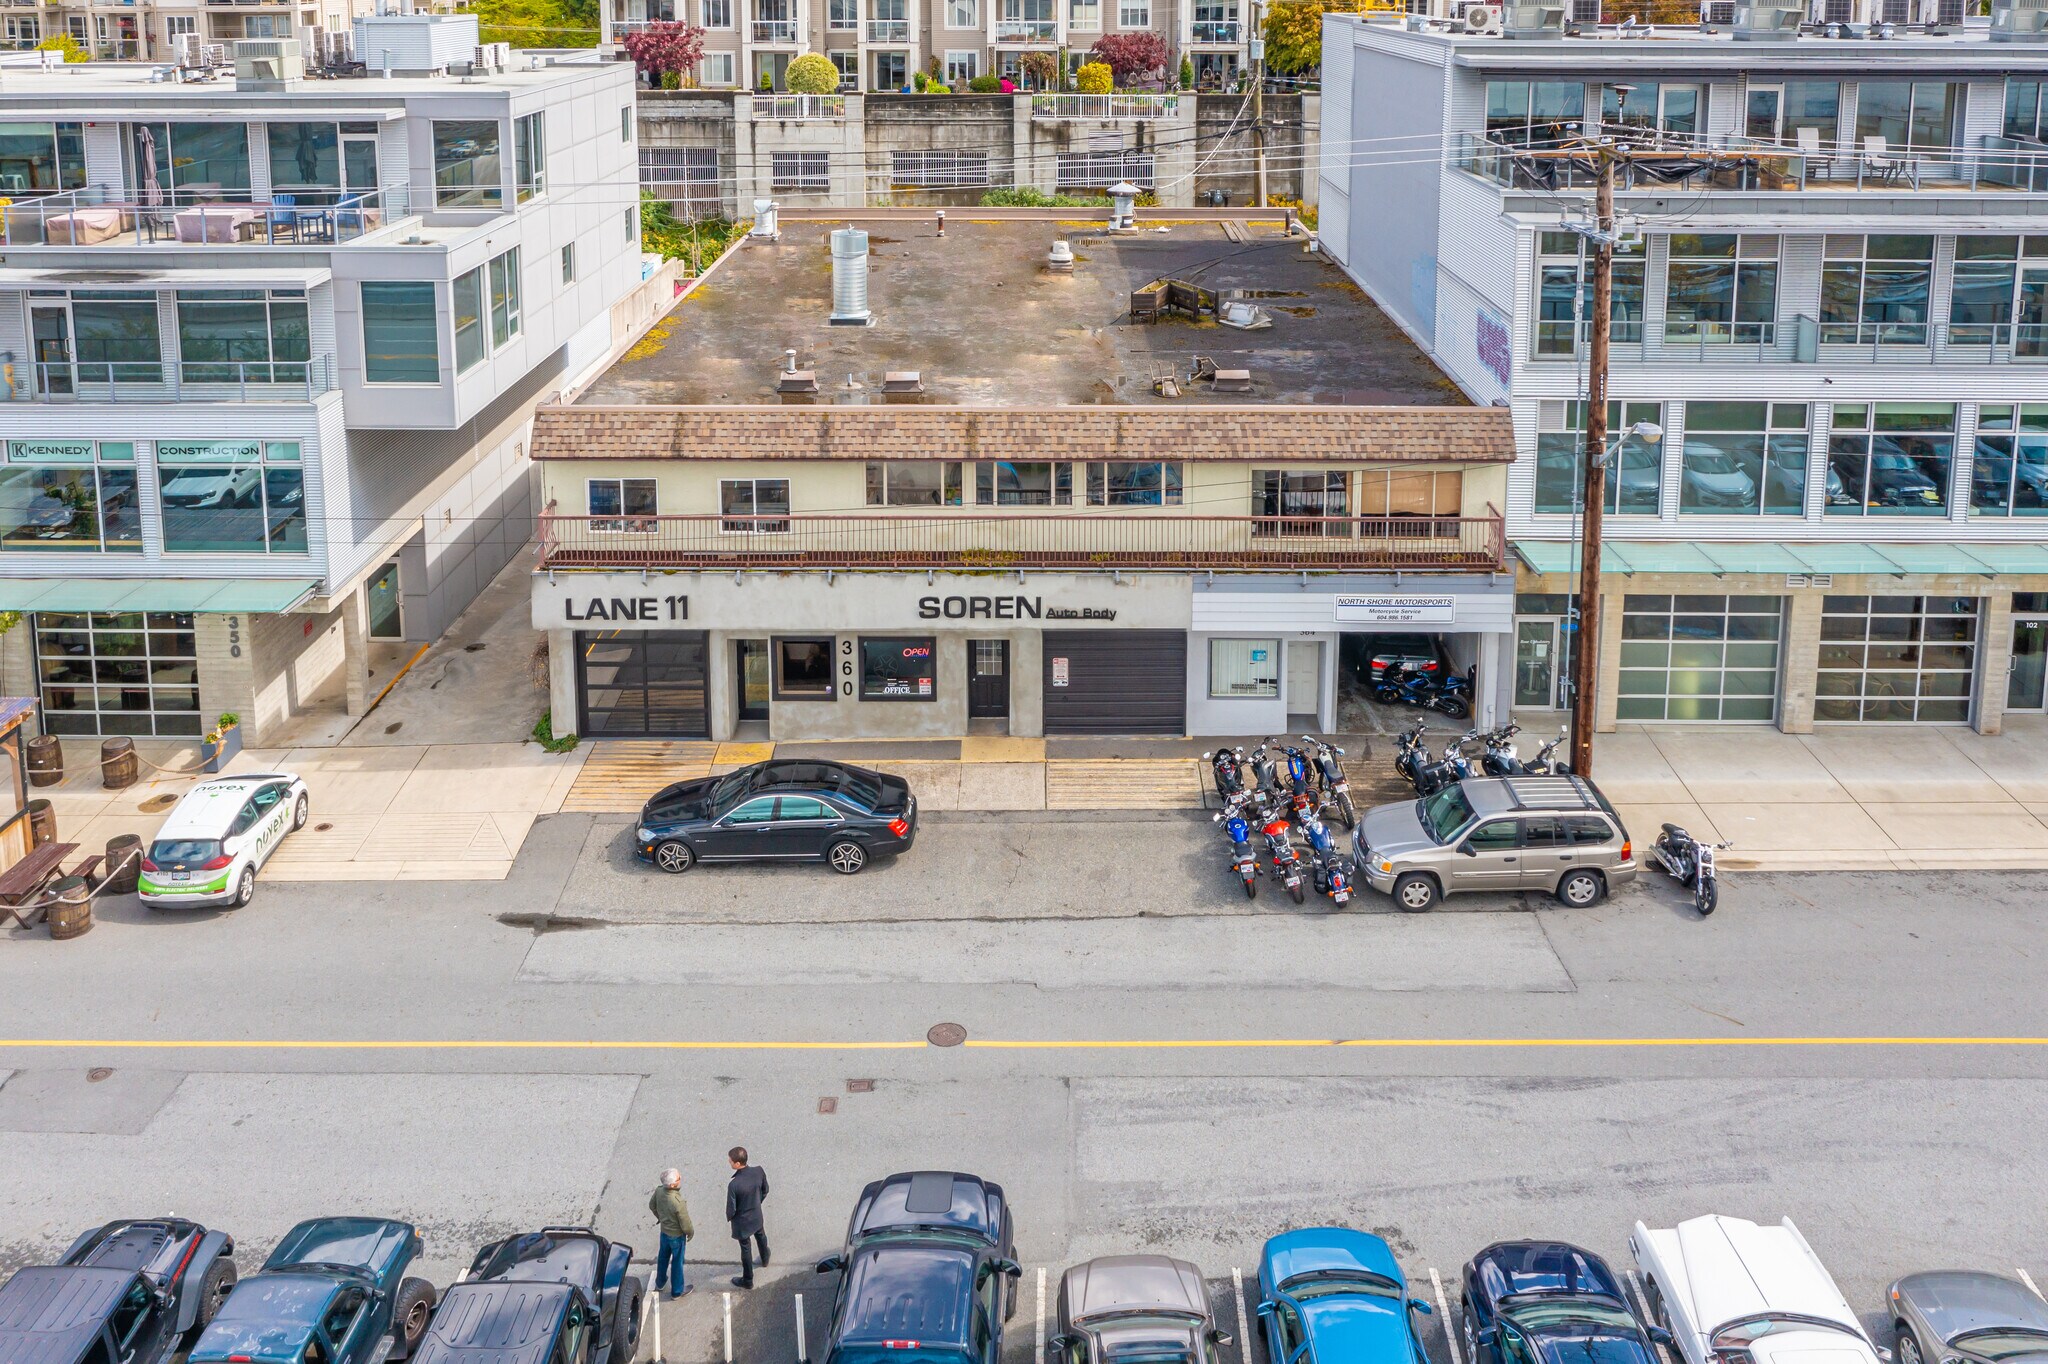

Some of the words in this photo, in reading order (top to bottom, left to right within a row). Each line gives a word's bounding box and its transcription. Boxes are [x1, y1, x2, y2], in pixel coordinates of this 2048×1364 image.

[28, 446, 91, 455] KENNEDY
[160, 446, 259, 455] CONSTRUCTION
[565, 598, 658, 621] LANE
[665, 595, 689, 620] 11
[918, 596, 1042, 619] SOREN
[1046, 607, 1078, 619] Auto
[1083, 608, 1117, 621] Body
[229, 617, 241, 657] 350
[902, 648, 930, 657] OPEN
[842, 641, 853, 696] 360
